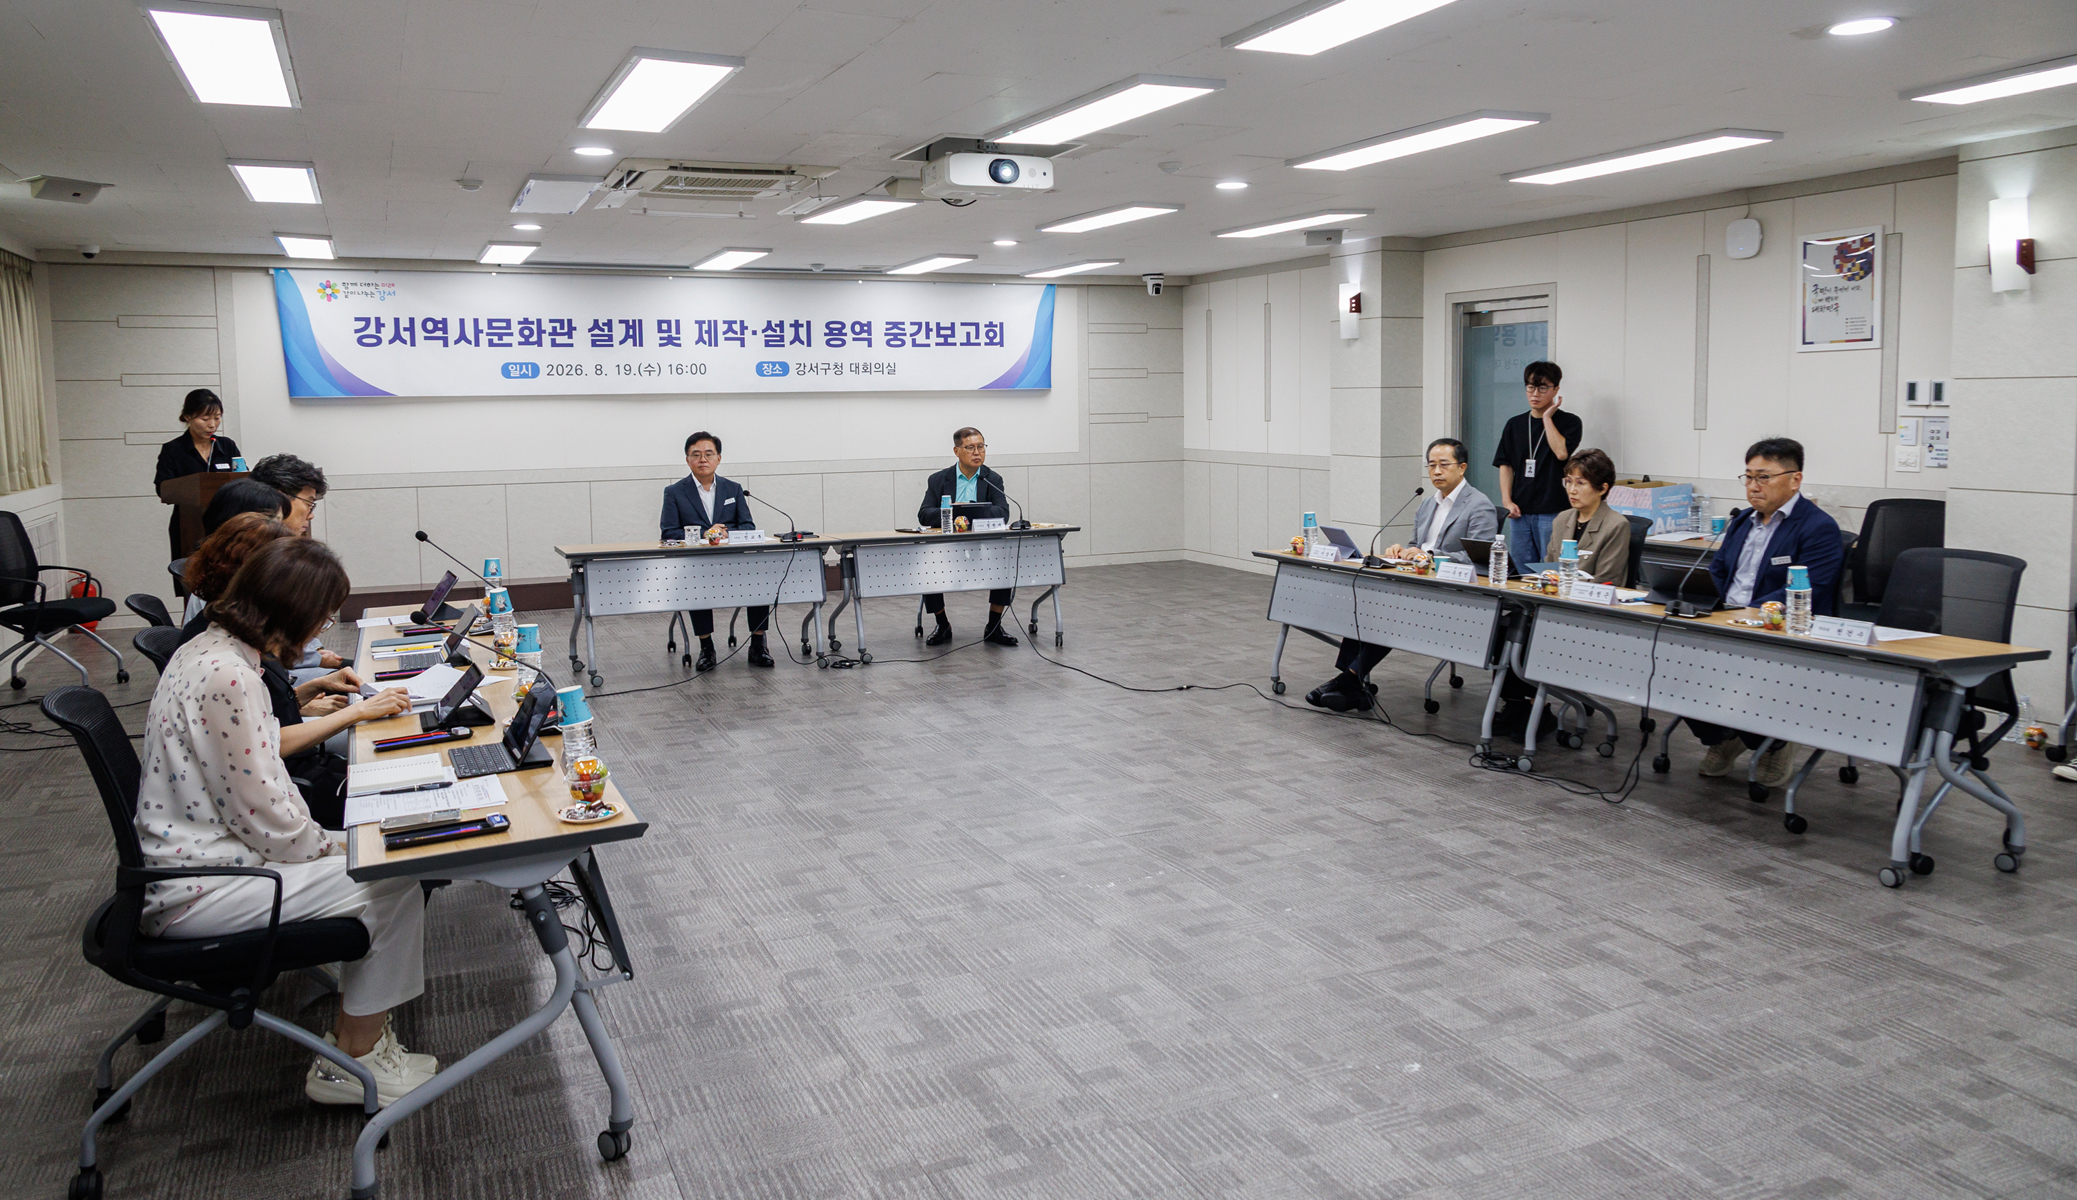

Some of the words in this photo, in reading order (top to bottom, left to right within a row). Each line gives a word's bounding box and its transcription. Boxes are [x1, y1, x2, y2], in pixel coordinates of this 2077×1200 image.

[342, 282, 358, 290] 함께
[360, 282, 380, 290] 더하는
[342, 290, 356, 298] 같이
[376, 290, 396, 301] 강서
[353, 316, 578, 348] 강서역사문화관
[587, 318, 644, 348] 설계
[656, 319, 682, 348] 및
[694, 319, 812, 348] 제작·설치
[823, 320, 873, 348] 용역
[883, 320, 1005, 348] 중간보고회
[508, 364, 532, 377] 일시
[546, 363, 588, 377] 2026.
[594, 363, 608, 377] 8.
[615, 362, 662, 377] 19.(수)
[667, 362, 707, 376] 16:00
[762, 363, 783, 376] 장소
[795, 362, 844, 376] 강서구청
[849, 362, 896, 376] 대회의실
[1655, 516, 1676, 534] A4
